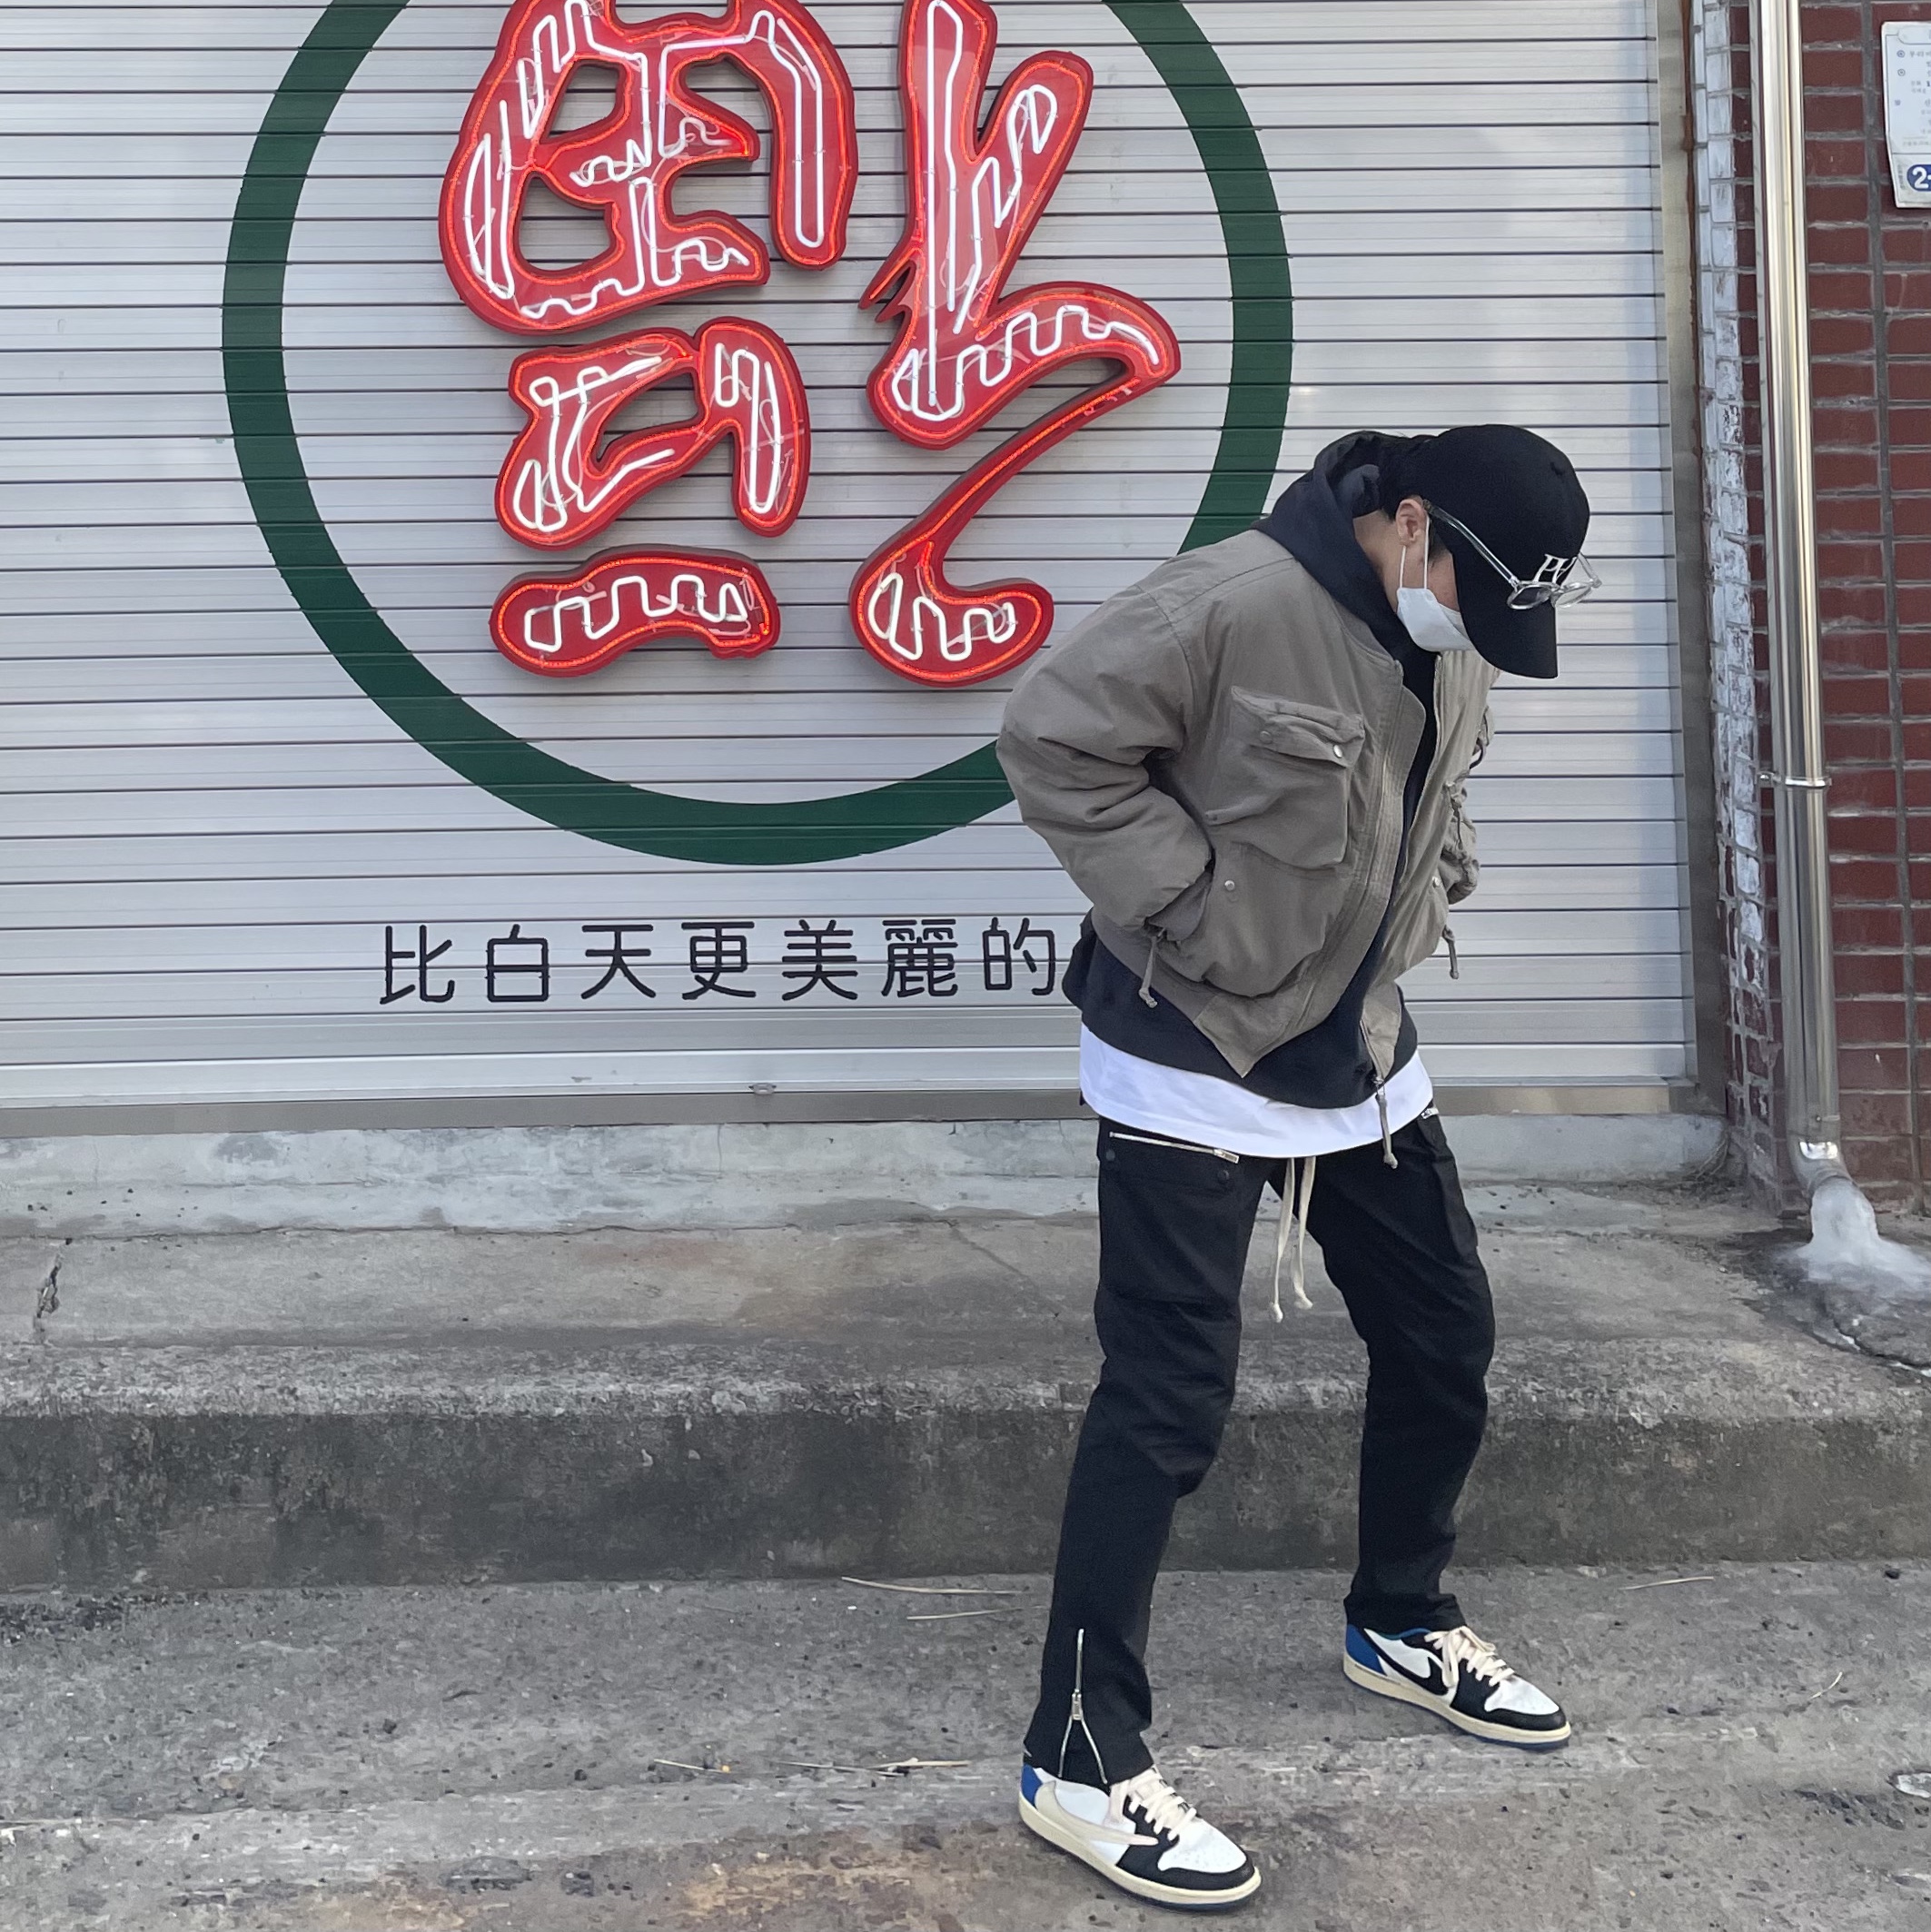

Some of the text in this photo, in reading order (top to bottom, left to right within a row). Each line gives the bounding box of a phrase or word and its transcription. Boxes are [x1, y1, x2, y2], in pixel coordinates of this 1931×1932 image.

[380, 916, 1056, 1005] 比白天更美麗的
